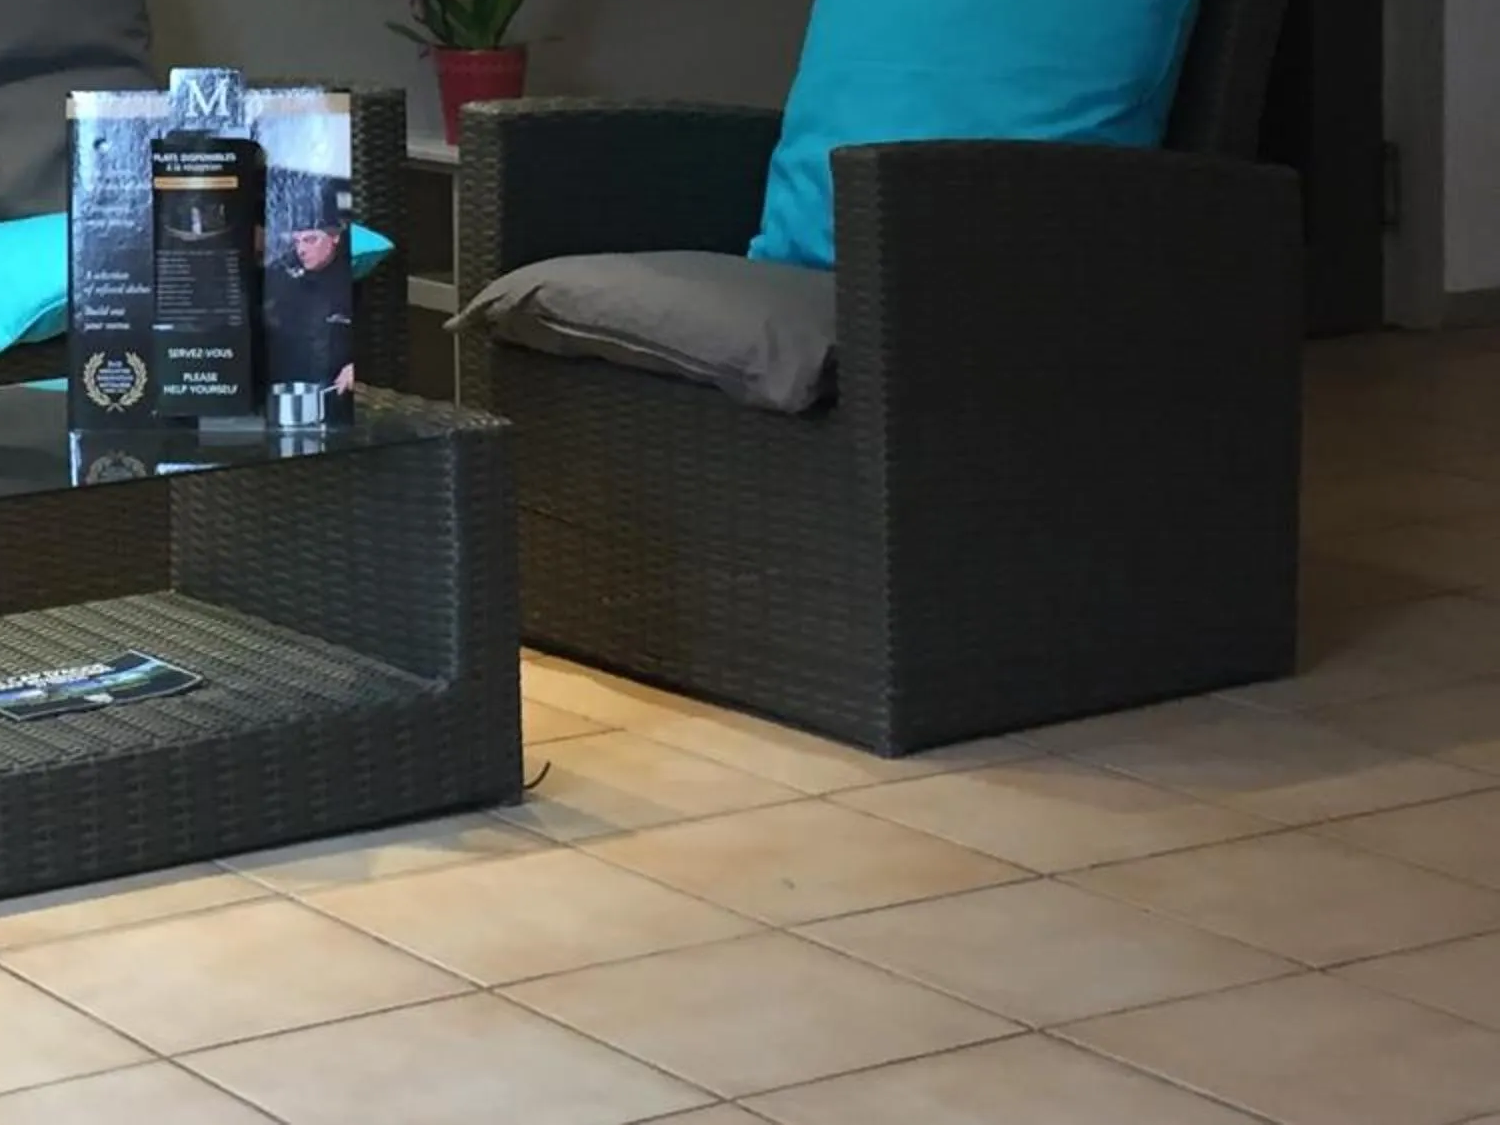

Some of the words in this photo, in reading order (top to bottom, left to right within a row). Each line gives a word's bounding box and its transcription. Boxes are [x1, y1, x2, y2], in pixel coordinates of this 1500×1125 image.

[183, 372, 218, 382] PLEASE
[163, 384, 187, 395] HELP
[190, 384, 238, 395] YOURSELF
